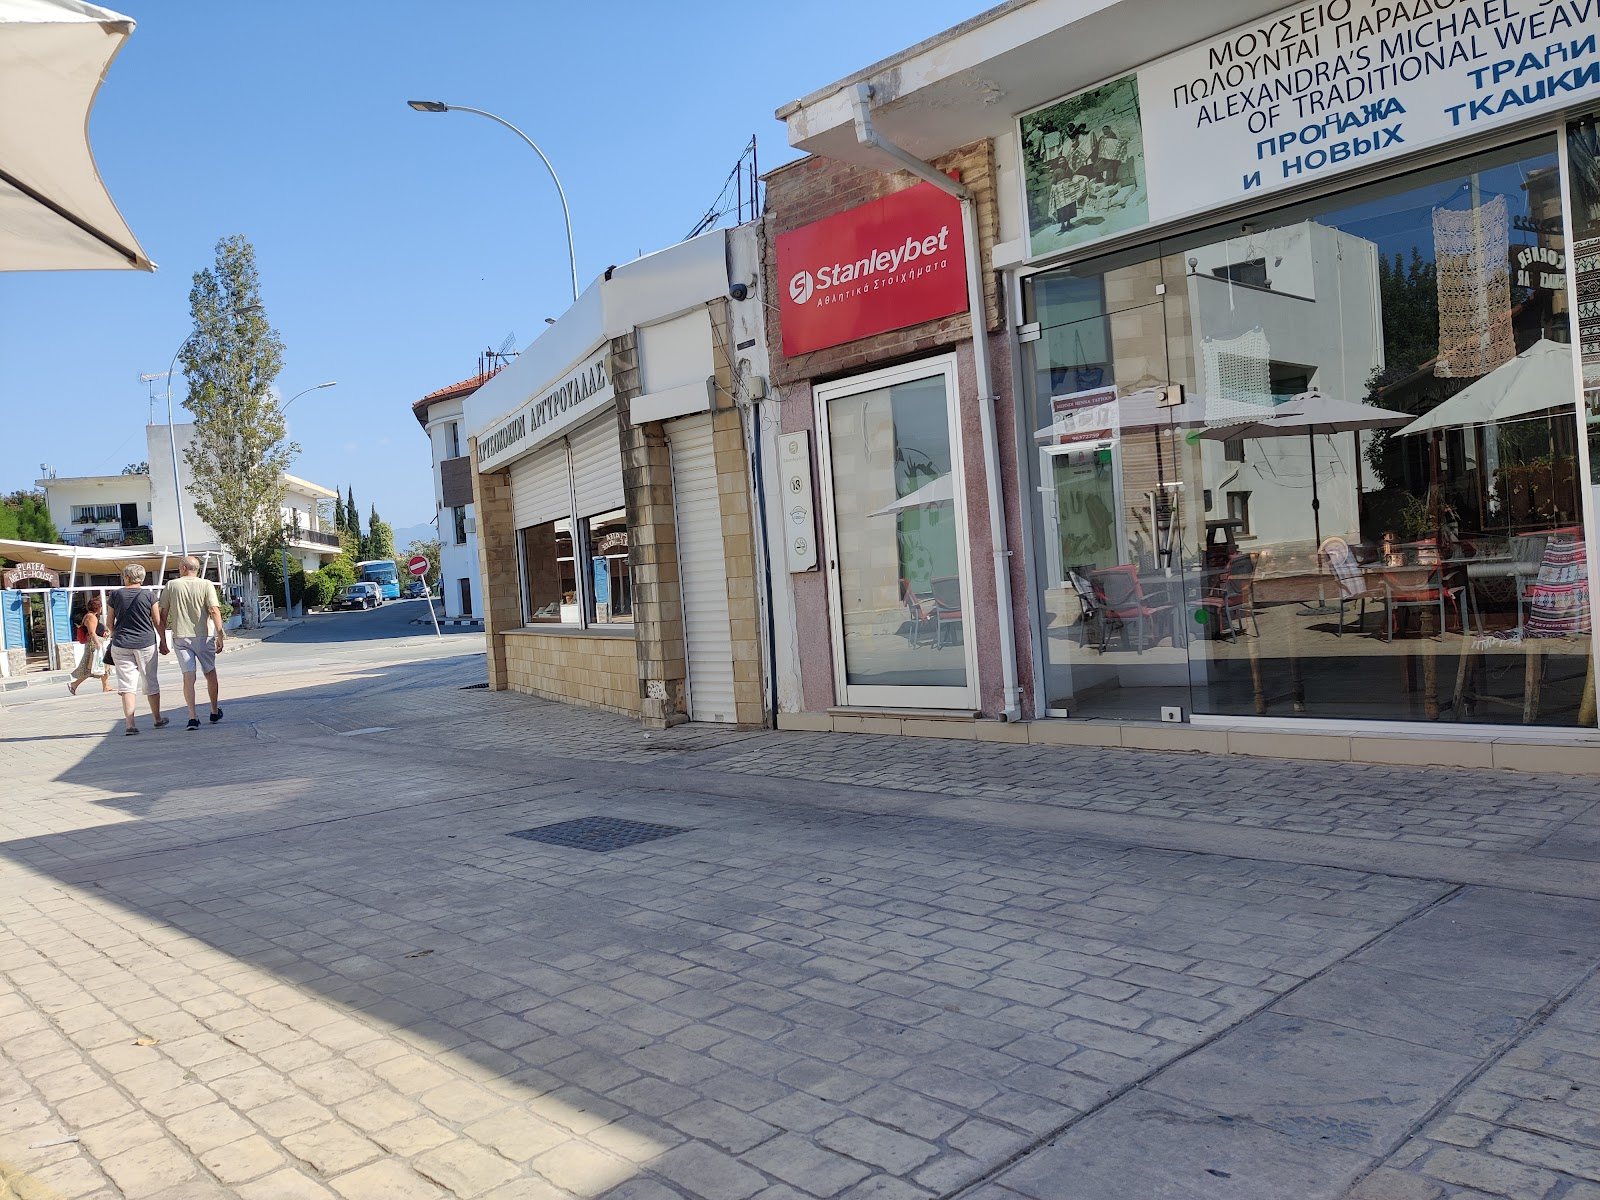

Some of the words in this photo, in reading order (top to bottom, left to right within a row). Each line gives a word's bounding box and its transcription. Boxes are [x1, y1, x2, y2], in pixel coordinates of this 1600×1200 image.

[1173, 33, 1320, 109] ΠΩΛΟΥΝΤΑΙ
[1335, 0, 1466, 49] ΠΑΡΑΔ
[1196, 45, 1371, 128] ALEXANDRA'S
[1380, 0, 1520, 63] MICHAEL
[1209, 0, 1351, 70] ΜΟΥΣΕΙΟ
[1247, 103, 1281, 134] OF
[1292, 35, 1488, 119] TRADITIONAL
[1256, 97, 1407, 160] ПРОДАЖА
[1282, 123, 1405, 178] НОВЫХ
[816, 226, 949, 290] Stanleybet
[816, 284, 869, 307] Αθλητικά
[873, 259, 948, 290] Στοιχήματα
[8, 570, 54, 584] MEZE-HOUSE
[16, 562, 46, 571] PLATEA
